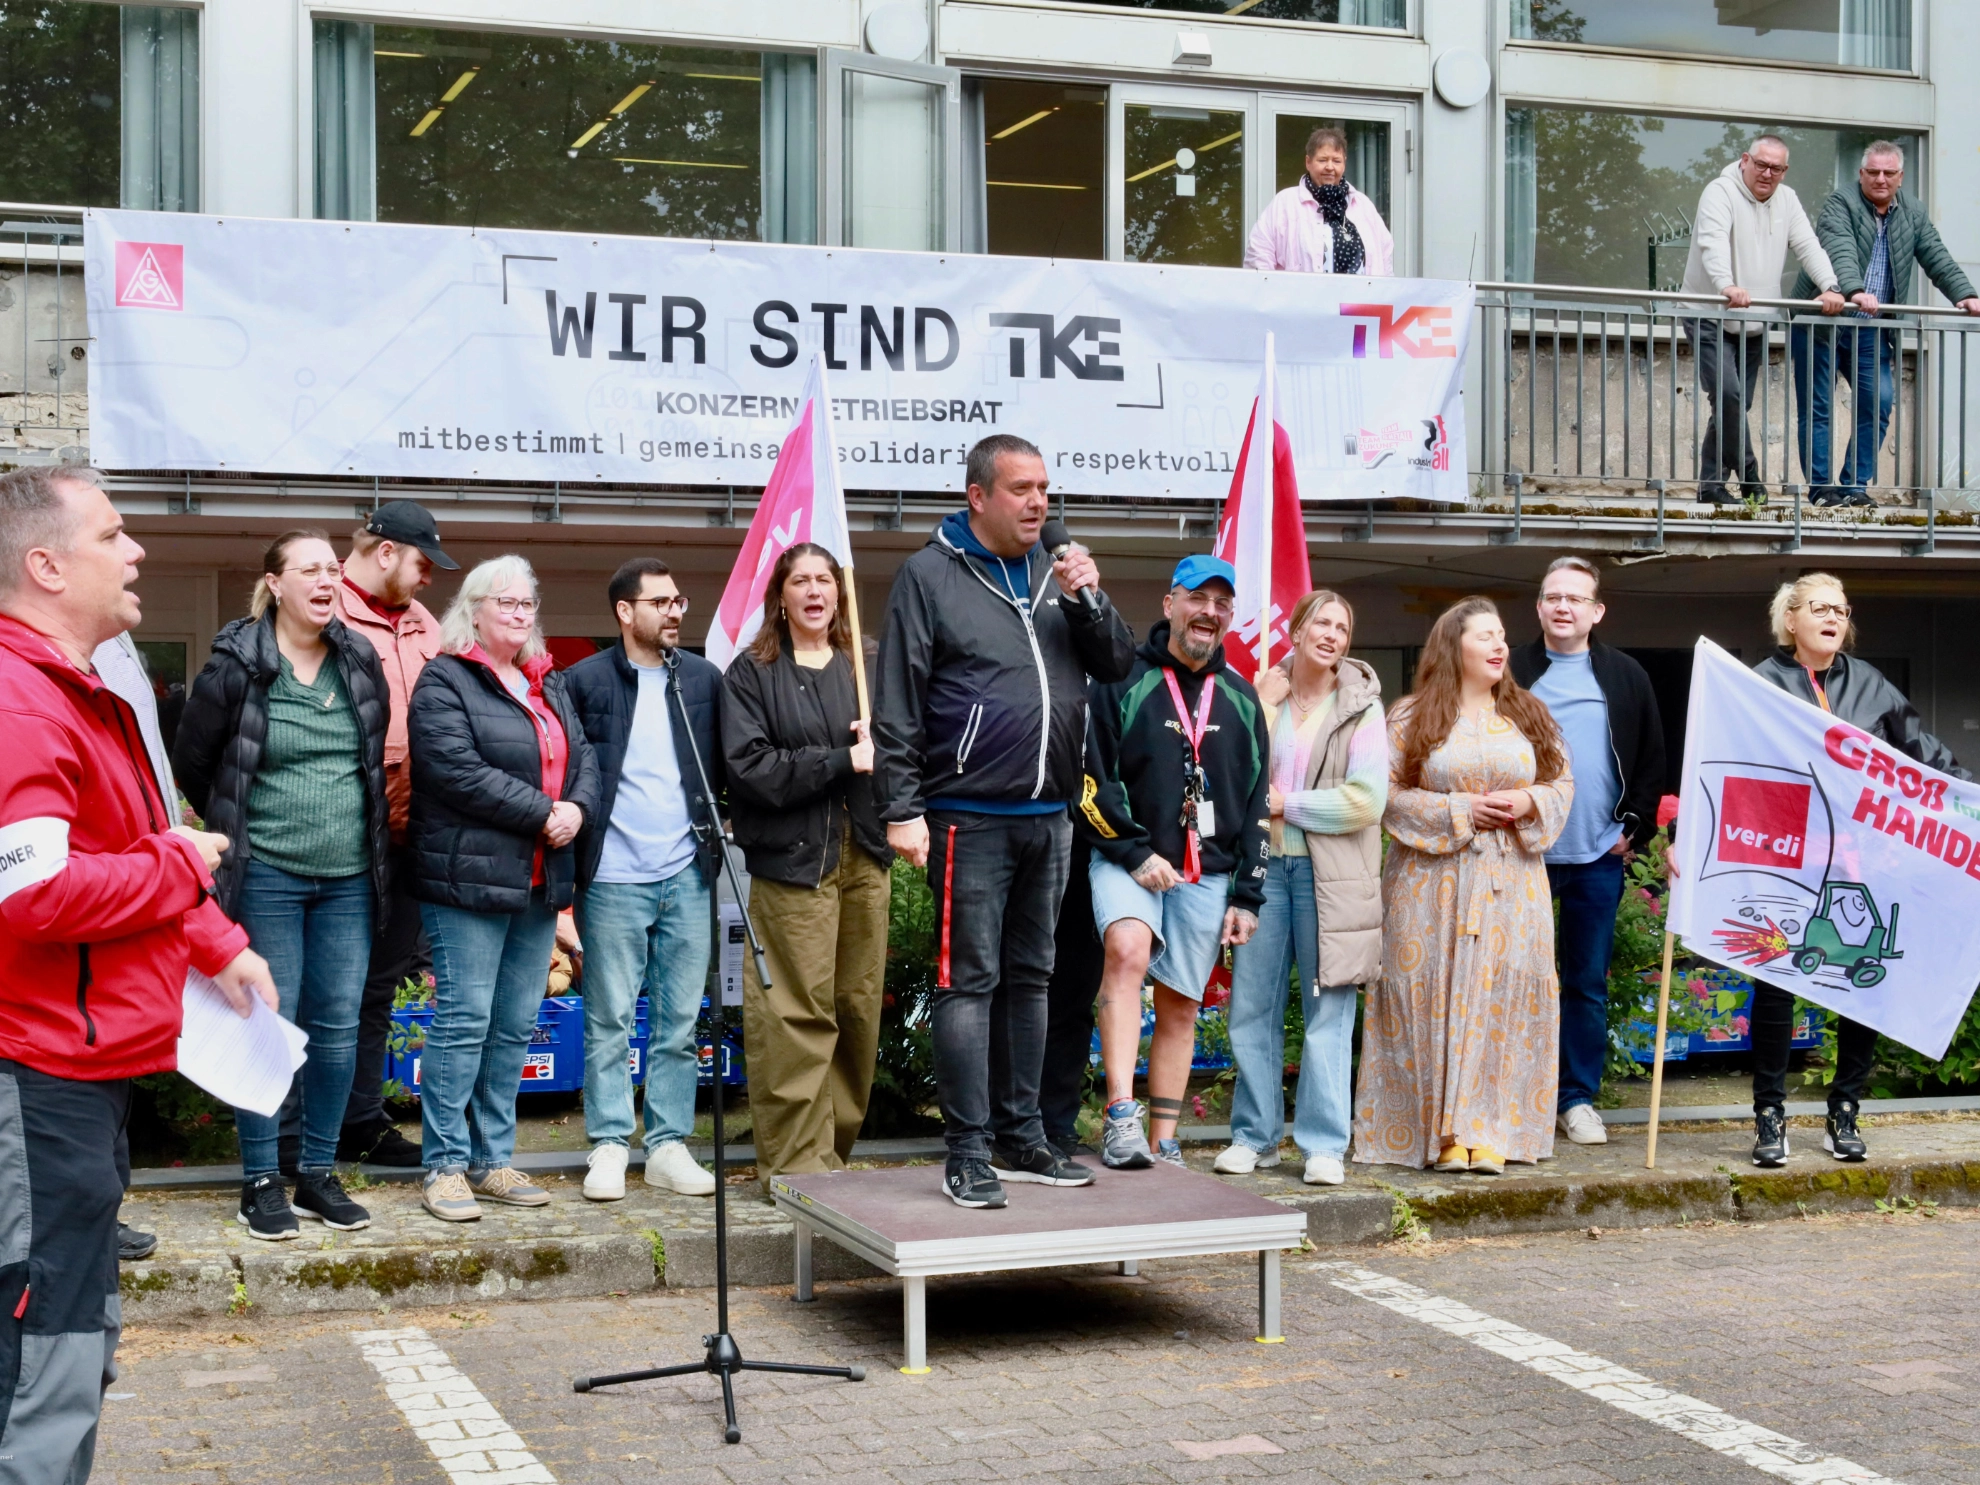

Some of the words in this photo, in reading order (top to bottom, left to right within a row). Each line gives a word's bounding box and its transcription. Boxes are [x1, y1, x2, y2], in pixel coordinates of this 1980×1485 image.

[545, 289, 706, 364] WIR
[750, 299, 960, 371] SIND
[989, 313, 1125, 381] TKE
[1339, 303, 1457, 359] TKE
[656, 391, 1002, 424] KONZERNETRIEBSRAT
[399, 426, 604, 454] mitbestimmt
[639, 436, 780, 463] gemeinsa
[1056, 448, 1235, 475] respektvoll
[0, 844, 37, 873] DNER
[1725, 823, 1801, 857] ver.di
